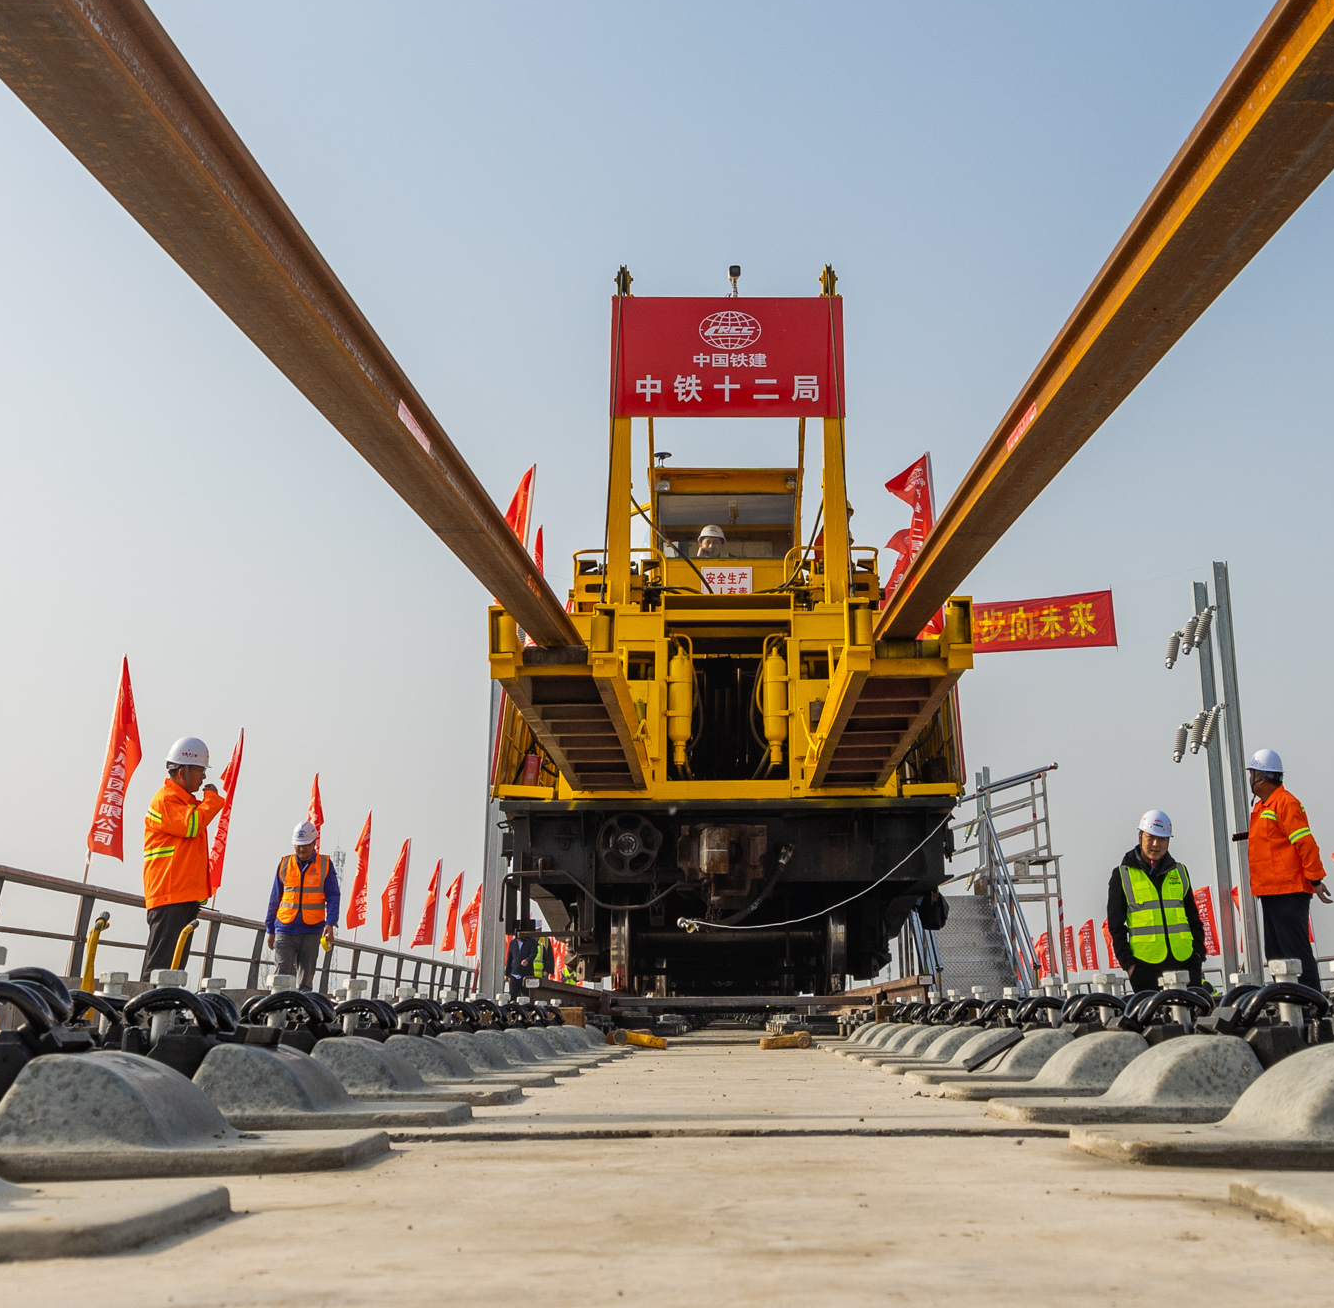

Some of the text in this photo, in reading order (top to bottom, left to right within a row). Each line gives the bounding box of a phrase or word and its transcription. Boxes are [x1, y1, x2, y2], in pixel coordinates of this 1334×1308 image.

[704, 325, 756, 336] CRCC
[693, 352, 767, 368] 中国铁建
[635, 374, 820, 403] 中铁十二局
[705, 571, 748, 585] 安全生产
[973, 601, 1097, 643] 步向未来
